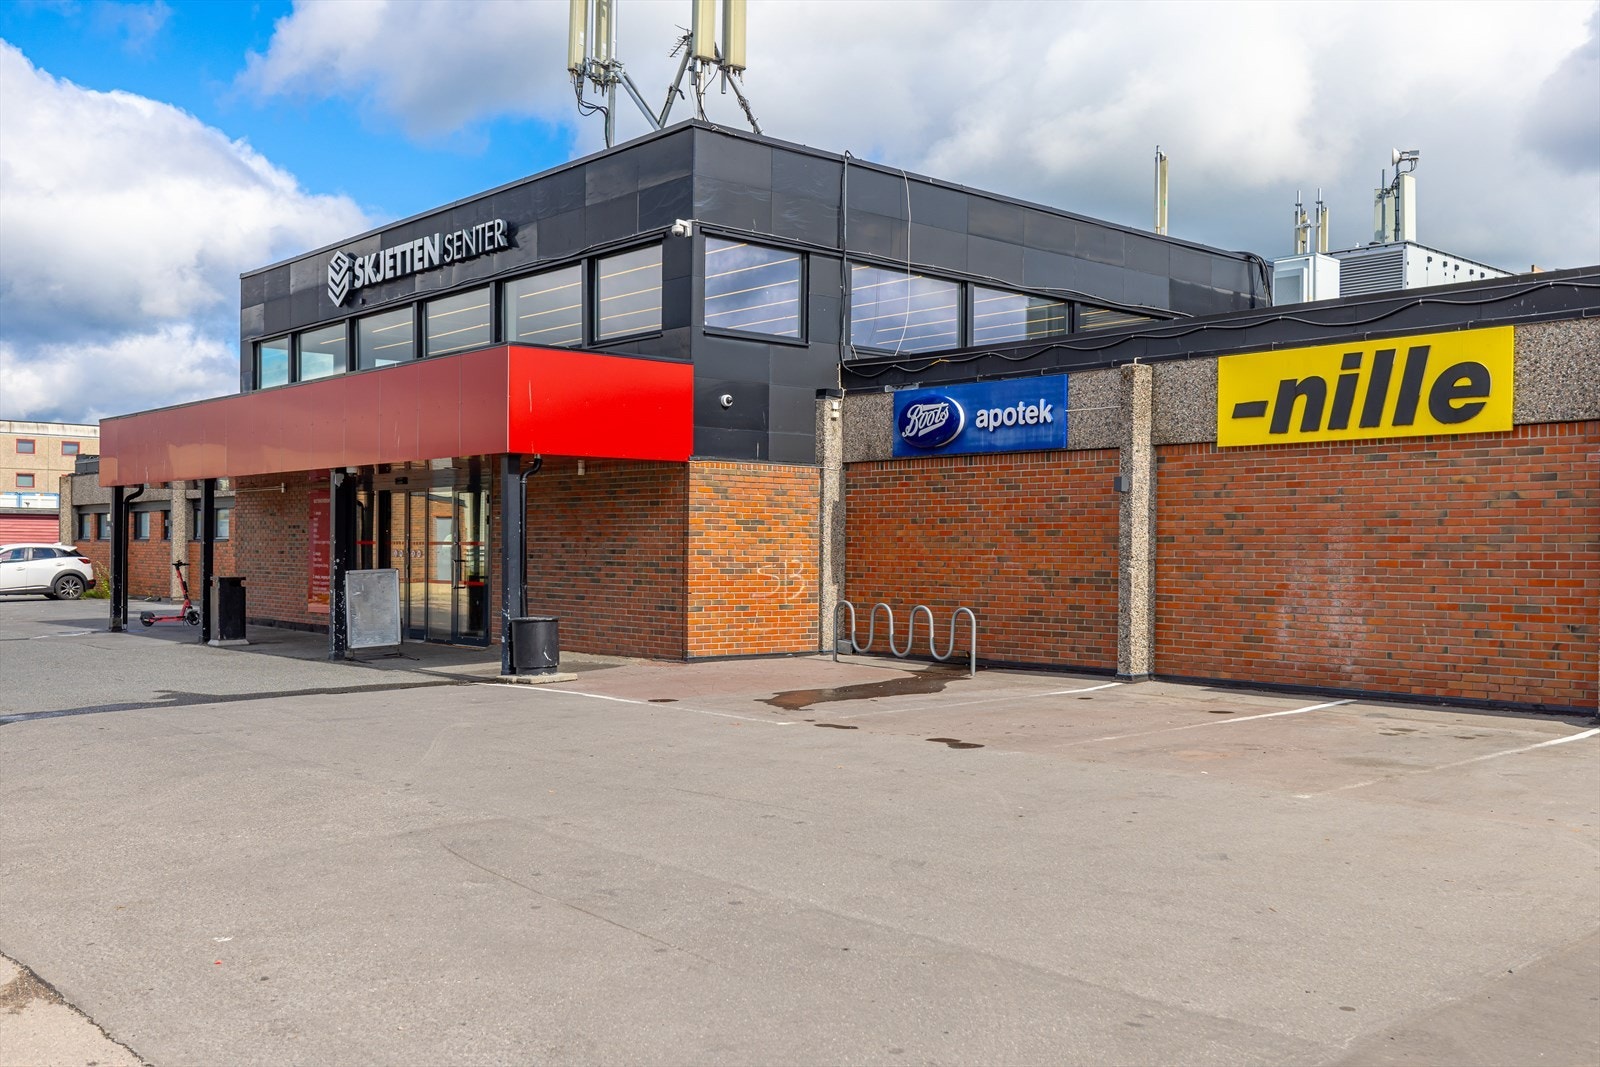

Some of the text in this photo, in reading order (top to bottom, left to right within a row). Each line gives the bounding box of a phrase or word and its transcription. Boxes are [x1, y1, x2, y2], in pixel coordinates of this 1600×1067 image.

[354, 218, 507, 288] SKJETTEN SENTER
[902, 398, 1053, 437] Boots apotek
